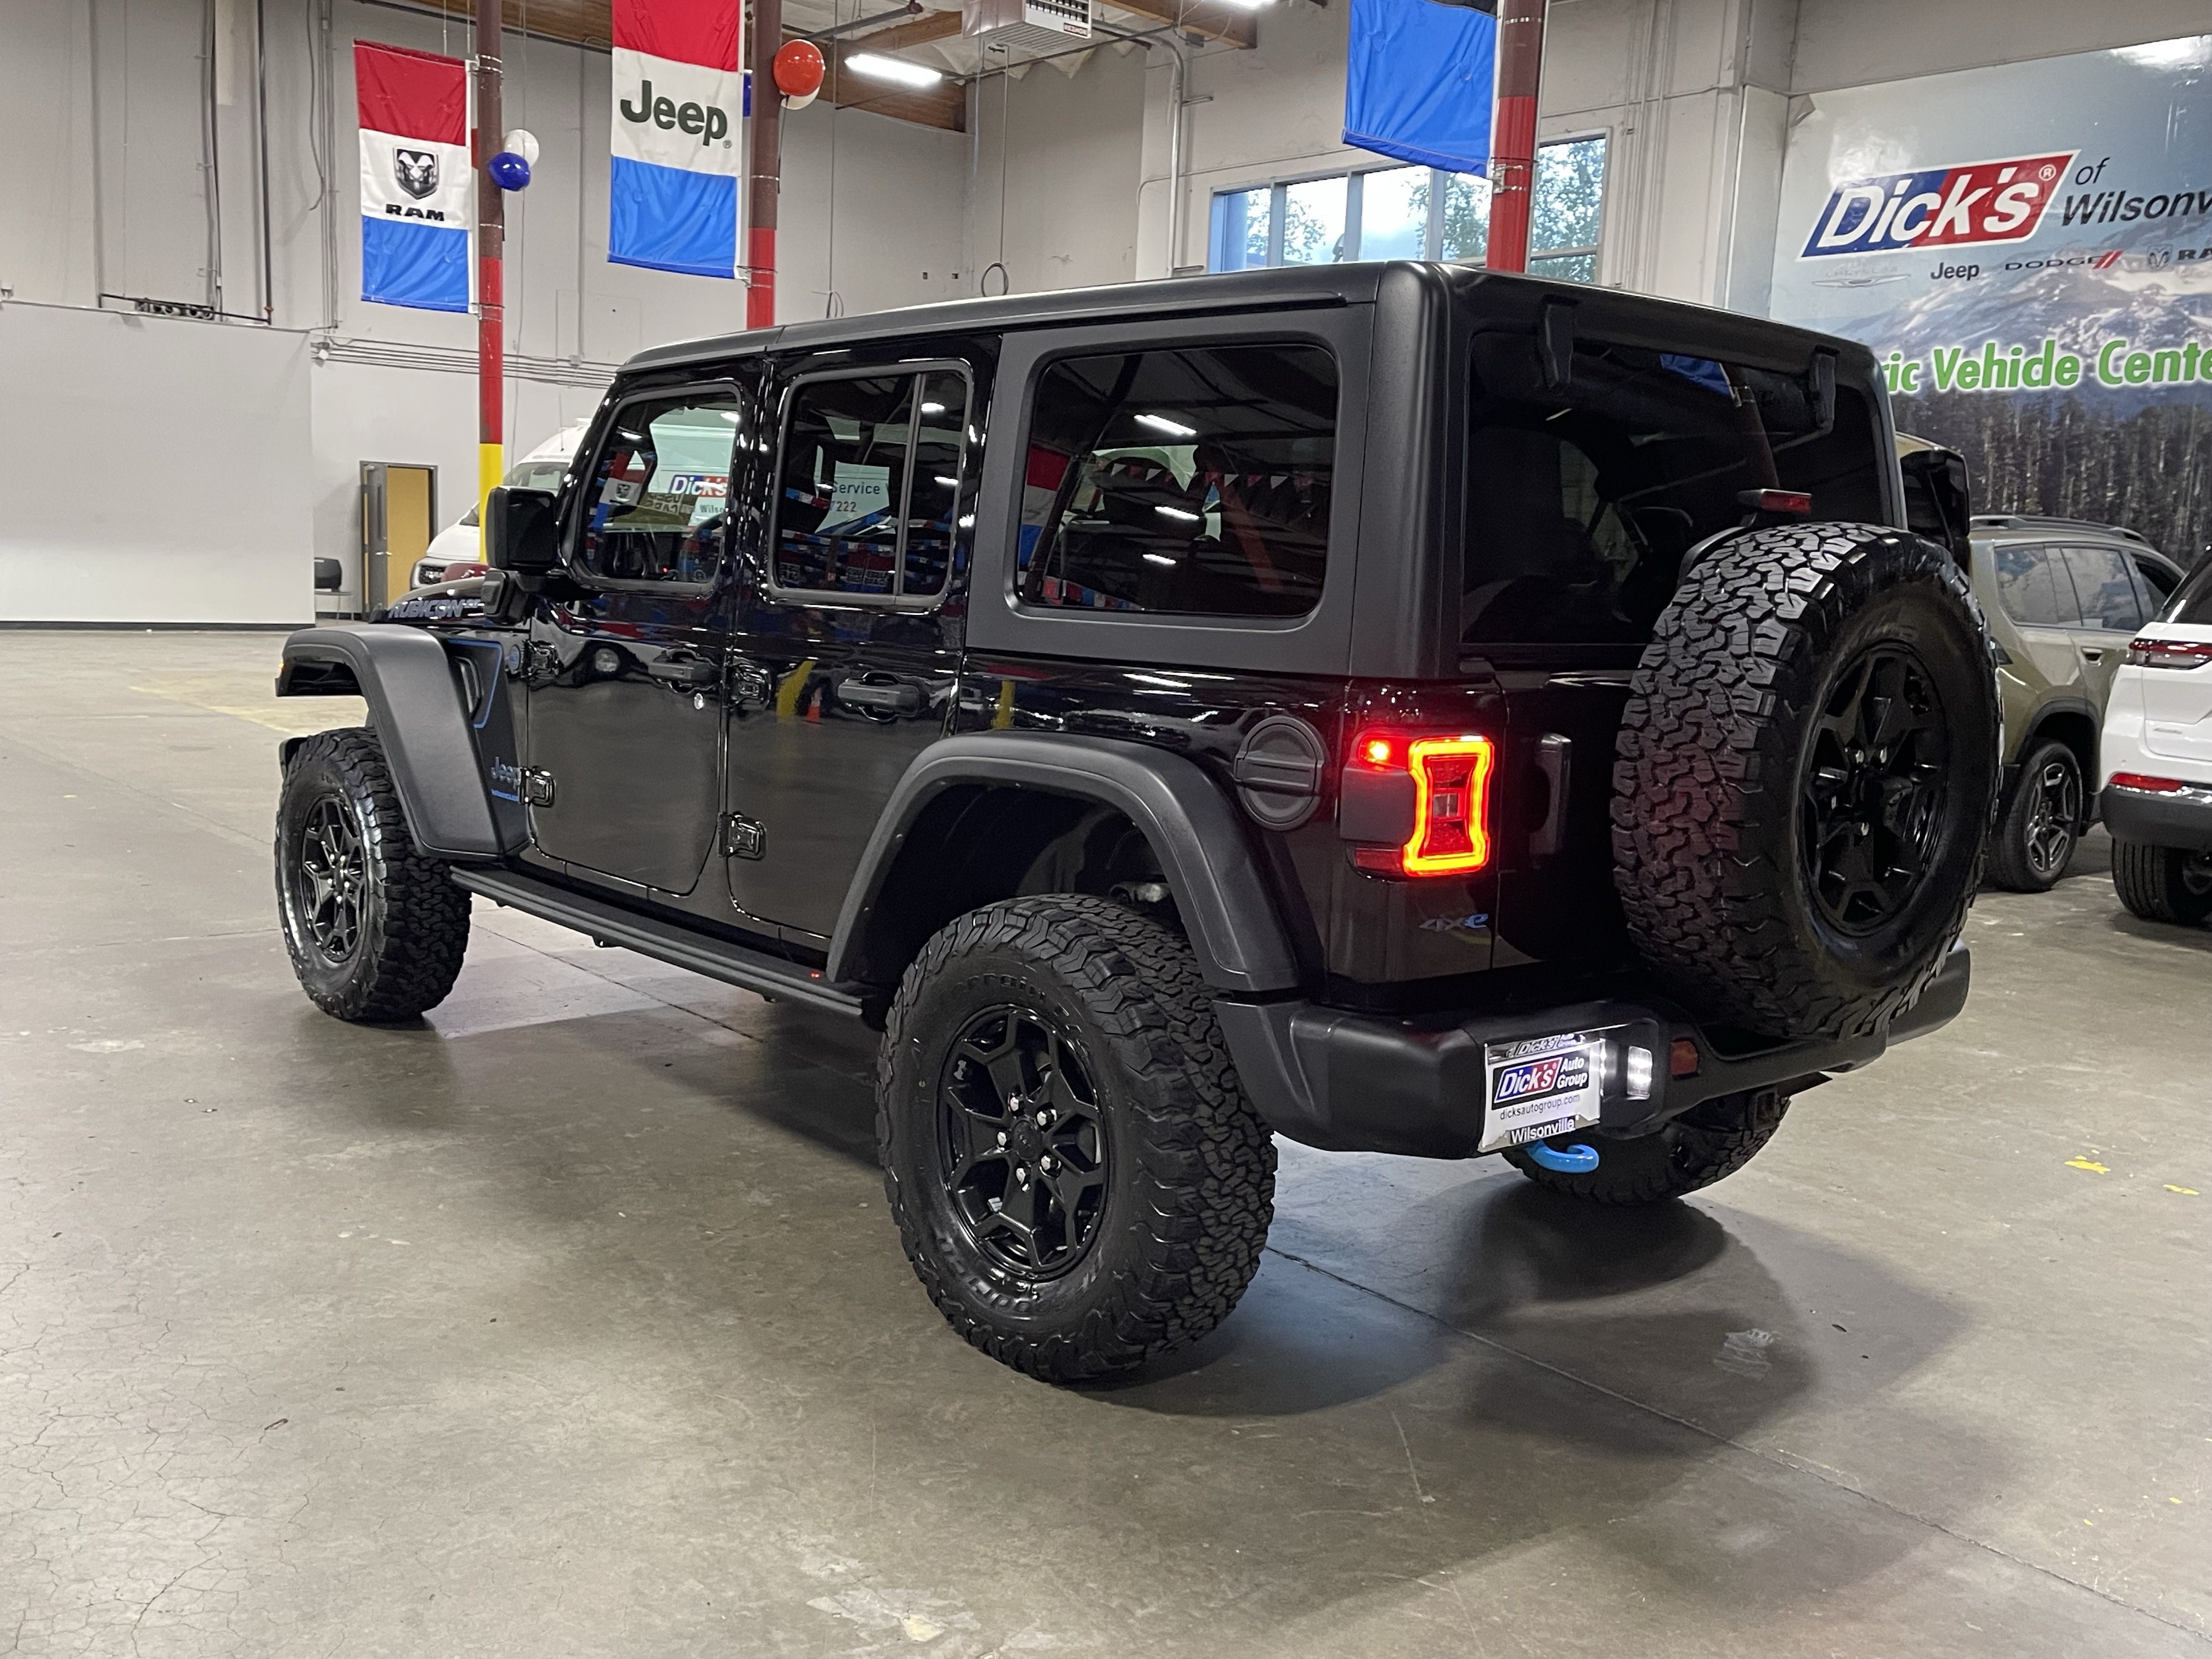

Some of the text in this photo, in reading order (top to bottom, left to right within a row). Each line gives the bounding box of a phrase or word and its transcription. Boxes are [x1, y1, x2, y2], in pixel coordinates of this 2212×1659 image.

[620, 80, 727, 146] Jeep
[386, 204, 444, 222] RAM
[1816, 157, 2111, 249] Dick's of
[1931, 262, 1979, 280] Jeep
[2005, 256, 2104, 270] DODGE
[1933, 340, 2080, 390] Vehicle
[387, 599, 465, 618] RUBICON
[1499, 1056, 1585, 1097] Dick's Auto
[1556, 1072, 1588, 1089] Group
[1500, 1094, 1580, 1120] dicksautogroup.com
[1511, 1118, 1575, 1144] Wilsonville
